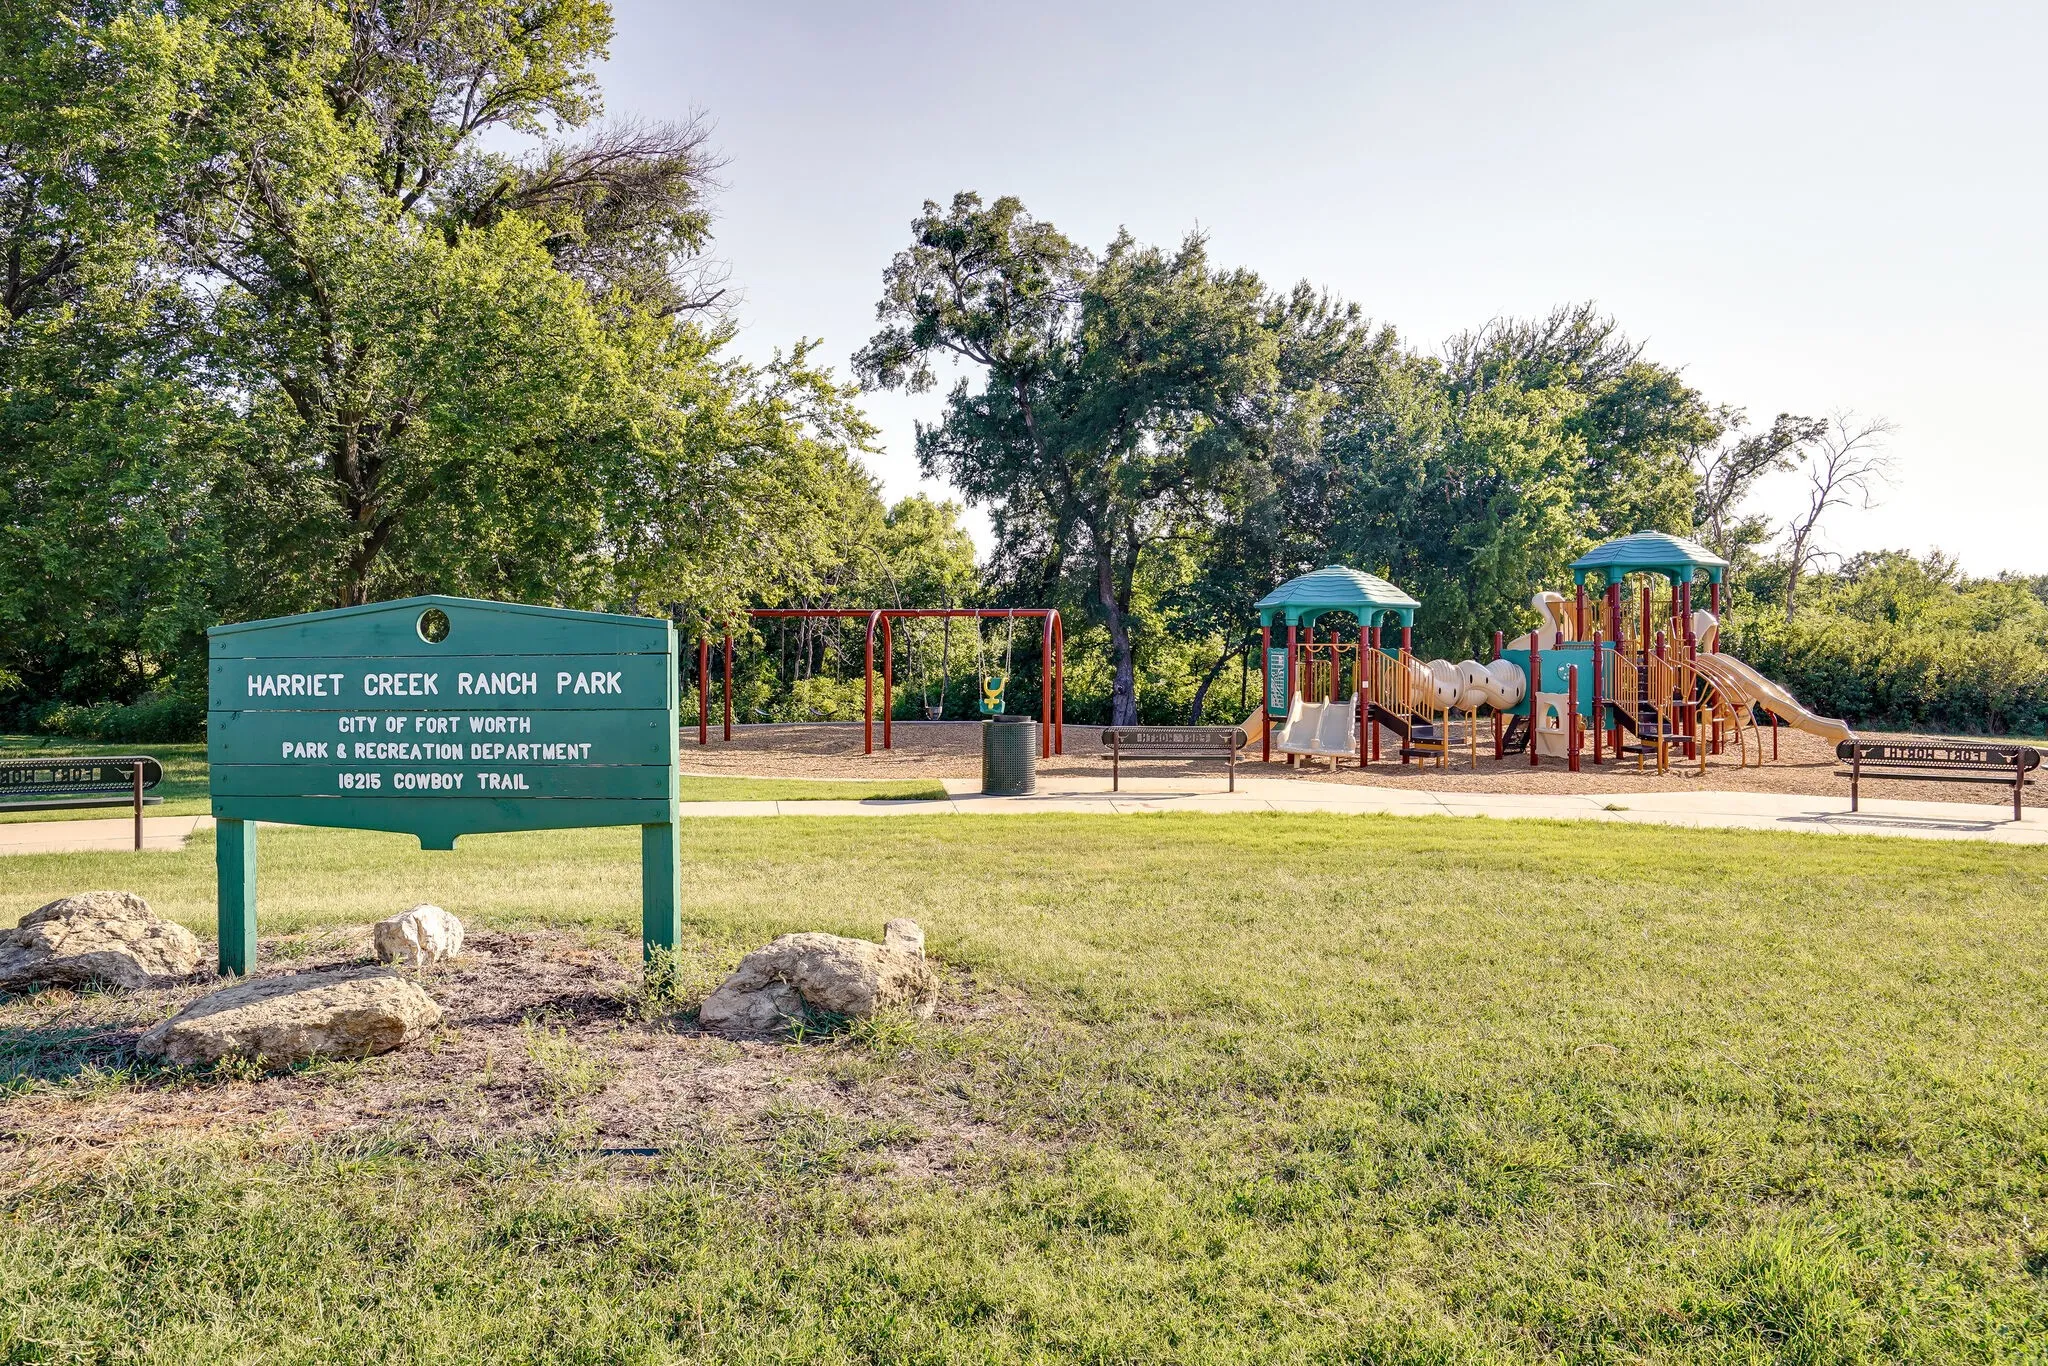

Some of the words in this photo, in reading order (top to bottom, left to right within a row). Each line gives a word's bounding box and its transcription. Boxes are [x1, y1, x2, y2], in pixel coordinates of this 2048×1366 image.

[247, 673, 345, 697] HARRIET
[363, 672, 439, 696] CREEK
[458, 672, 537, 695] RANCH
[557, 671, 622, 695] PARK
[338, 716, 378, 734] CITY
[385, 716, 408, 734] OF
[415, 716, 461, 734] FORT
[469, 716, 531, 734] WORTH
[282, 741, 329, 759] PARK
[336, 742, 347, 759] &
[354, 742, 464, 761] RECREATION
[470, 742, 592, 761] DEPARTMENT
[338, 772, 382, 790] 16215
[393, 772, 464, 790] COWBOY
[477, 772, 530, 790] TRAIL
